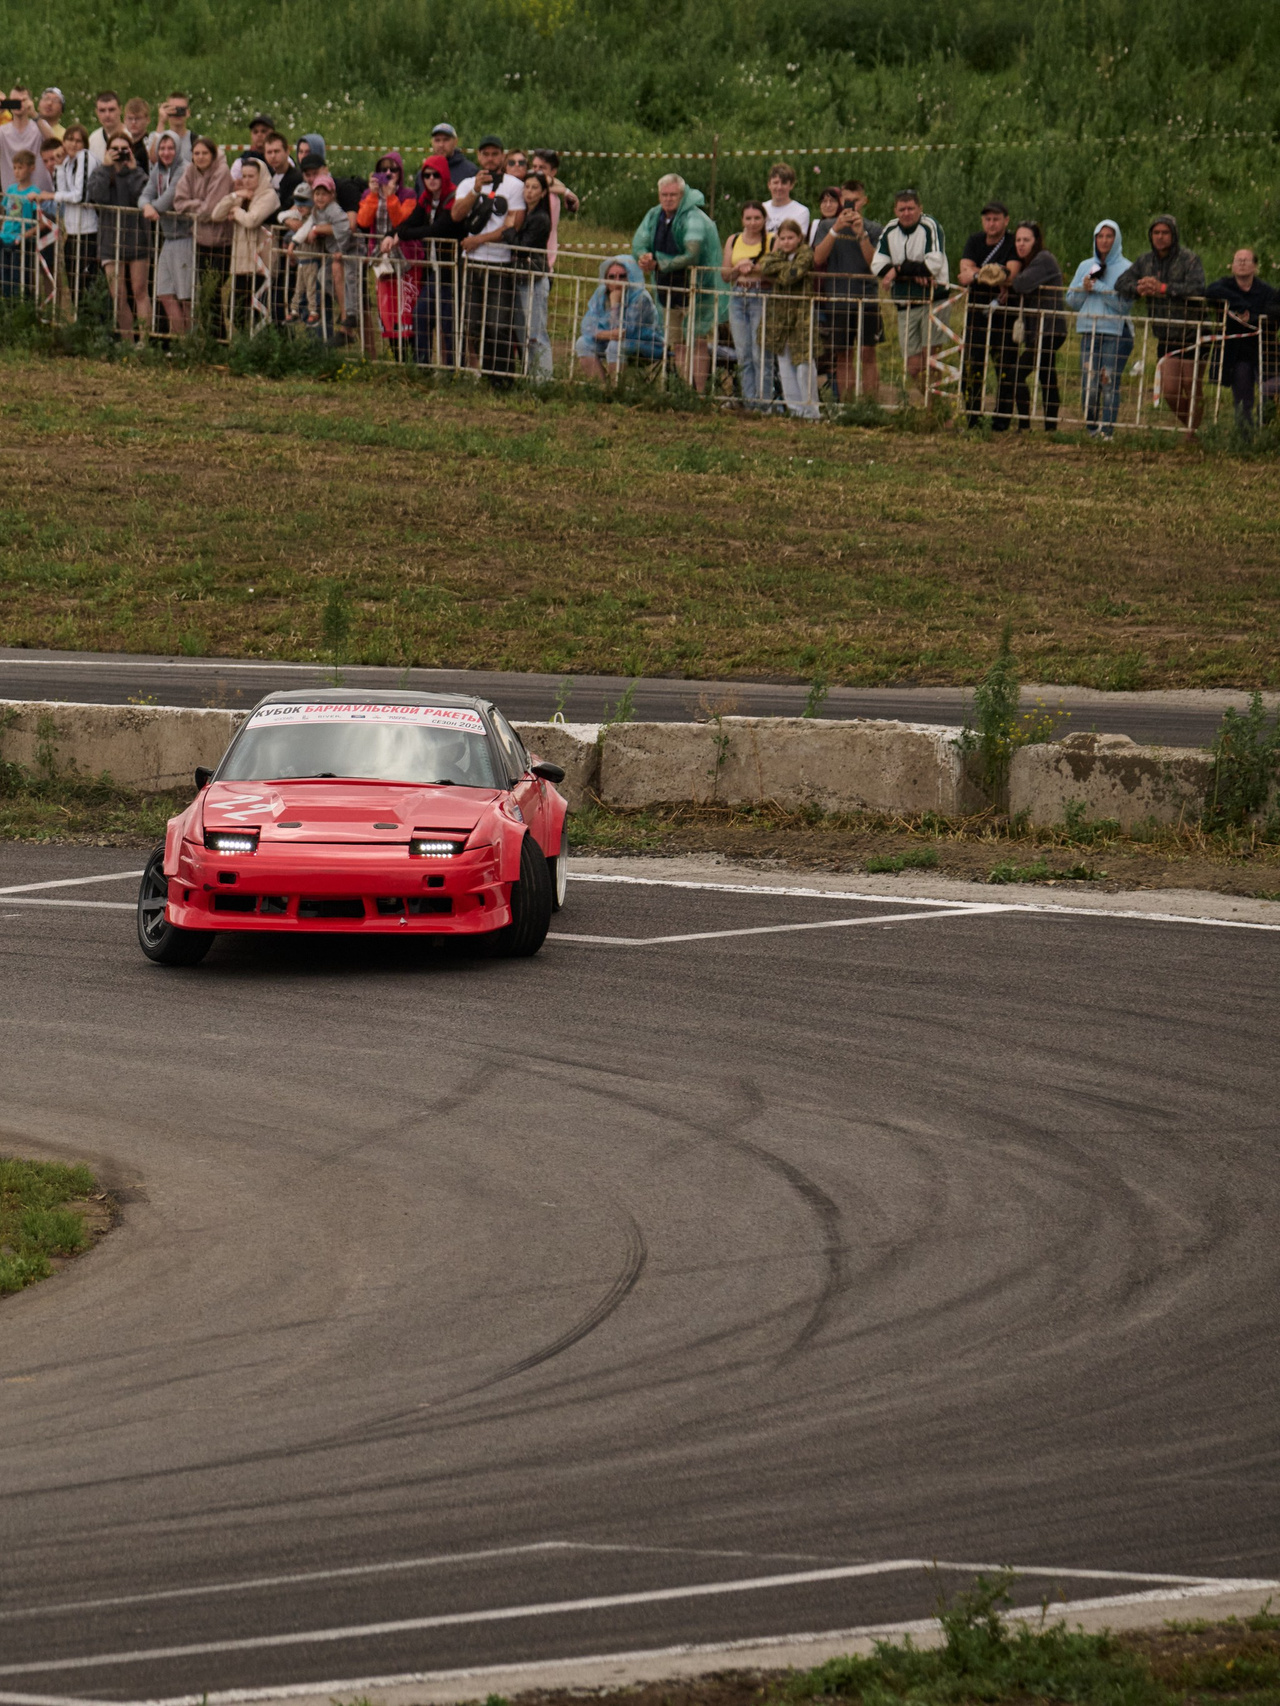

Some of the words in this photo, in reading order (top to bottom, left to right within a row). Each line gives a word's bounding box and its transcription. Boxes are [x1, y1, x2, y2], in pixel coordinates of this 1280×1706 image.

[254, 706, 303, 718] КУБОК
[304, 704, 420, 715] БАРНАУЛЬСКОЙ
[423, 708, 481, 723] РАКЕТЫ
[431, 719, 457, 727] СЕЗОН
[458, 721, 483, 731] 2025
[208, 794, 279, 821] 22
